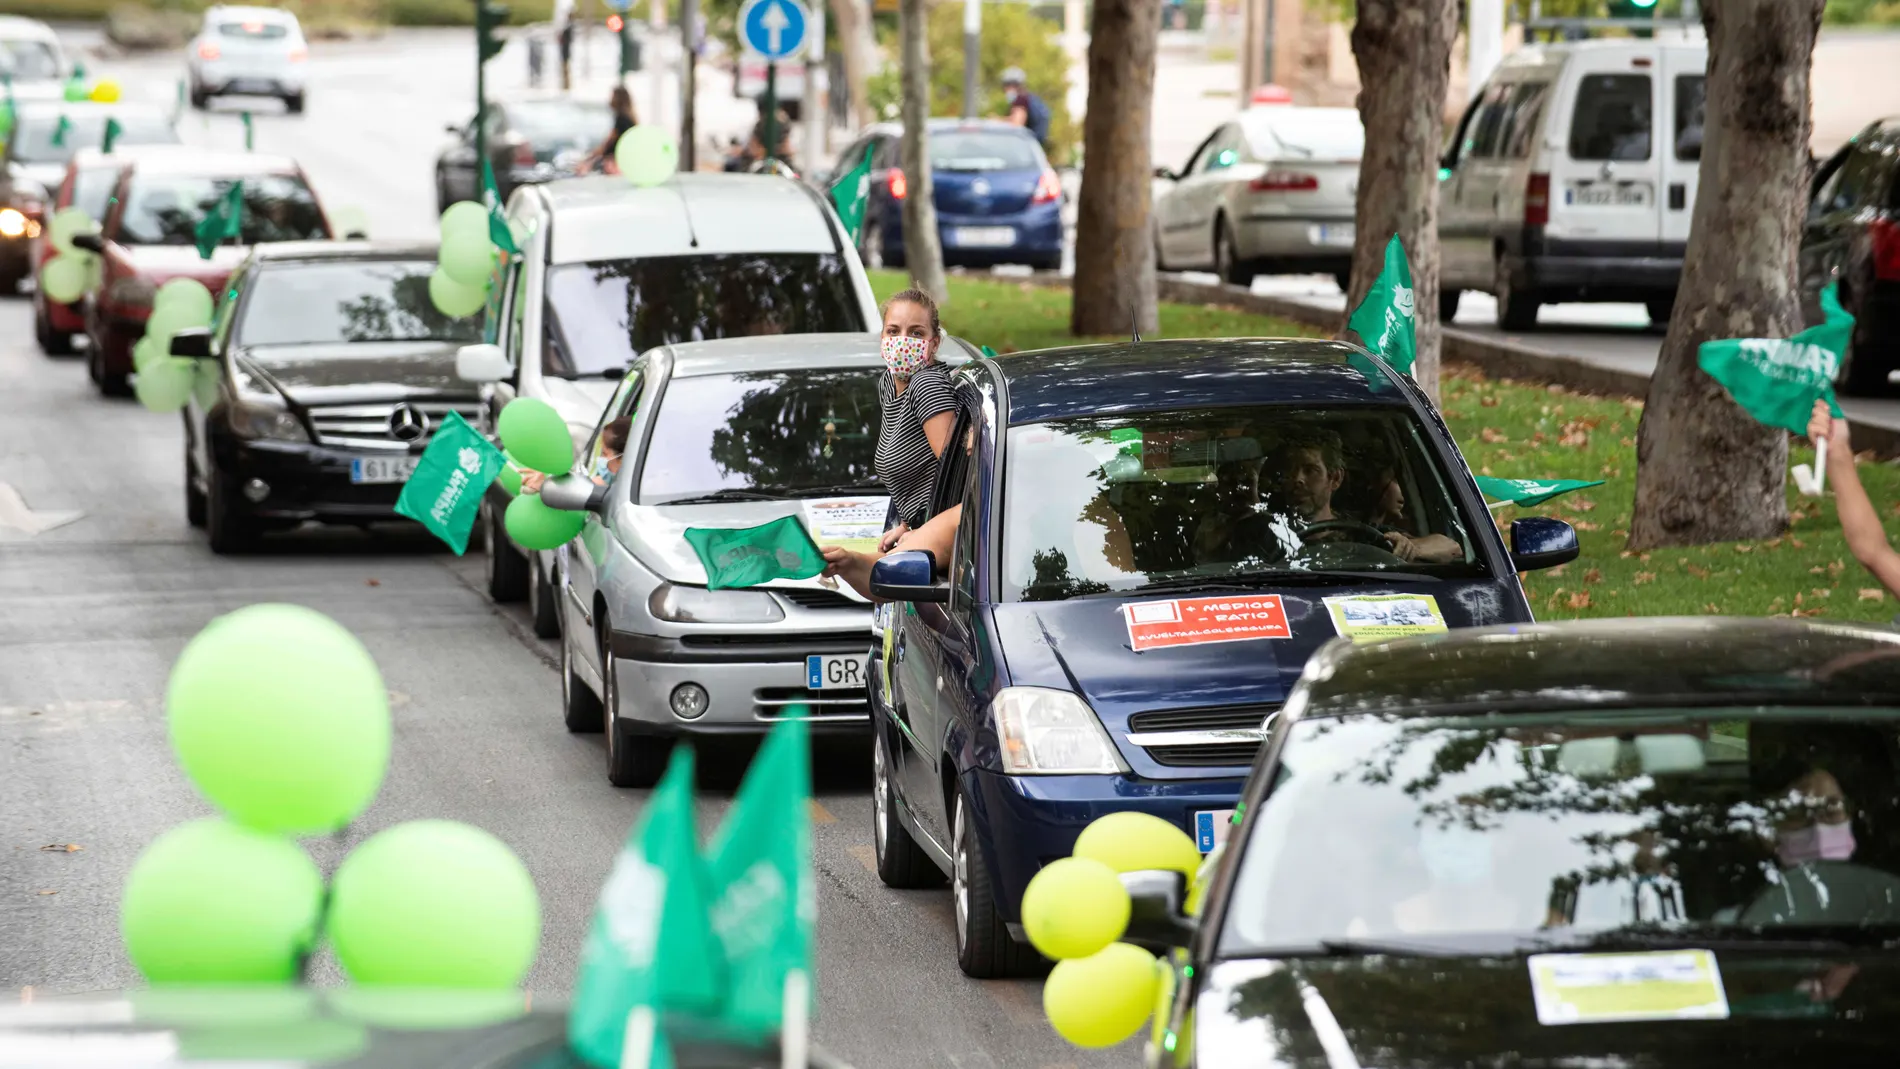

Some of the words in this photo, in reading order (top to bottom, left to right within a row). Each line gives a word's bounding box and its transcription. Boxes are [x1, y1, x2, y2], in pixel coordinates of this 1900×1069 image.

[1203, 601, 1276, 612] MEDIOS
[1215, 612, 1269, 622] RATIO
[1137, 624, 1284, 641] #VUELTAALCOLESEGURA
[812, 675, 819, 683] E
[827, 658, 866, 684] GR
[1202, 836, 1210, 846] E
